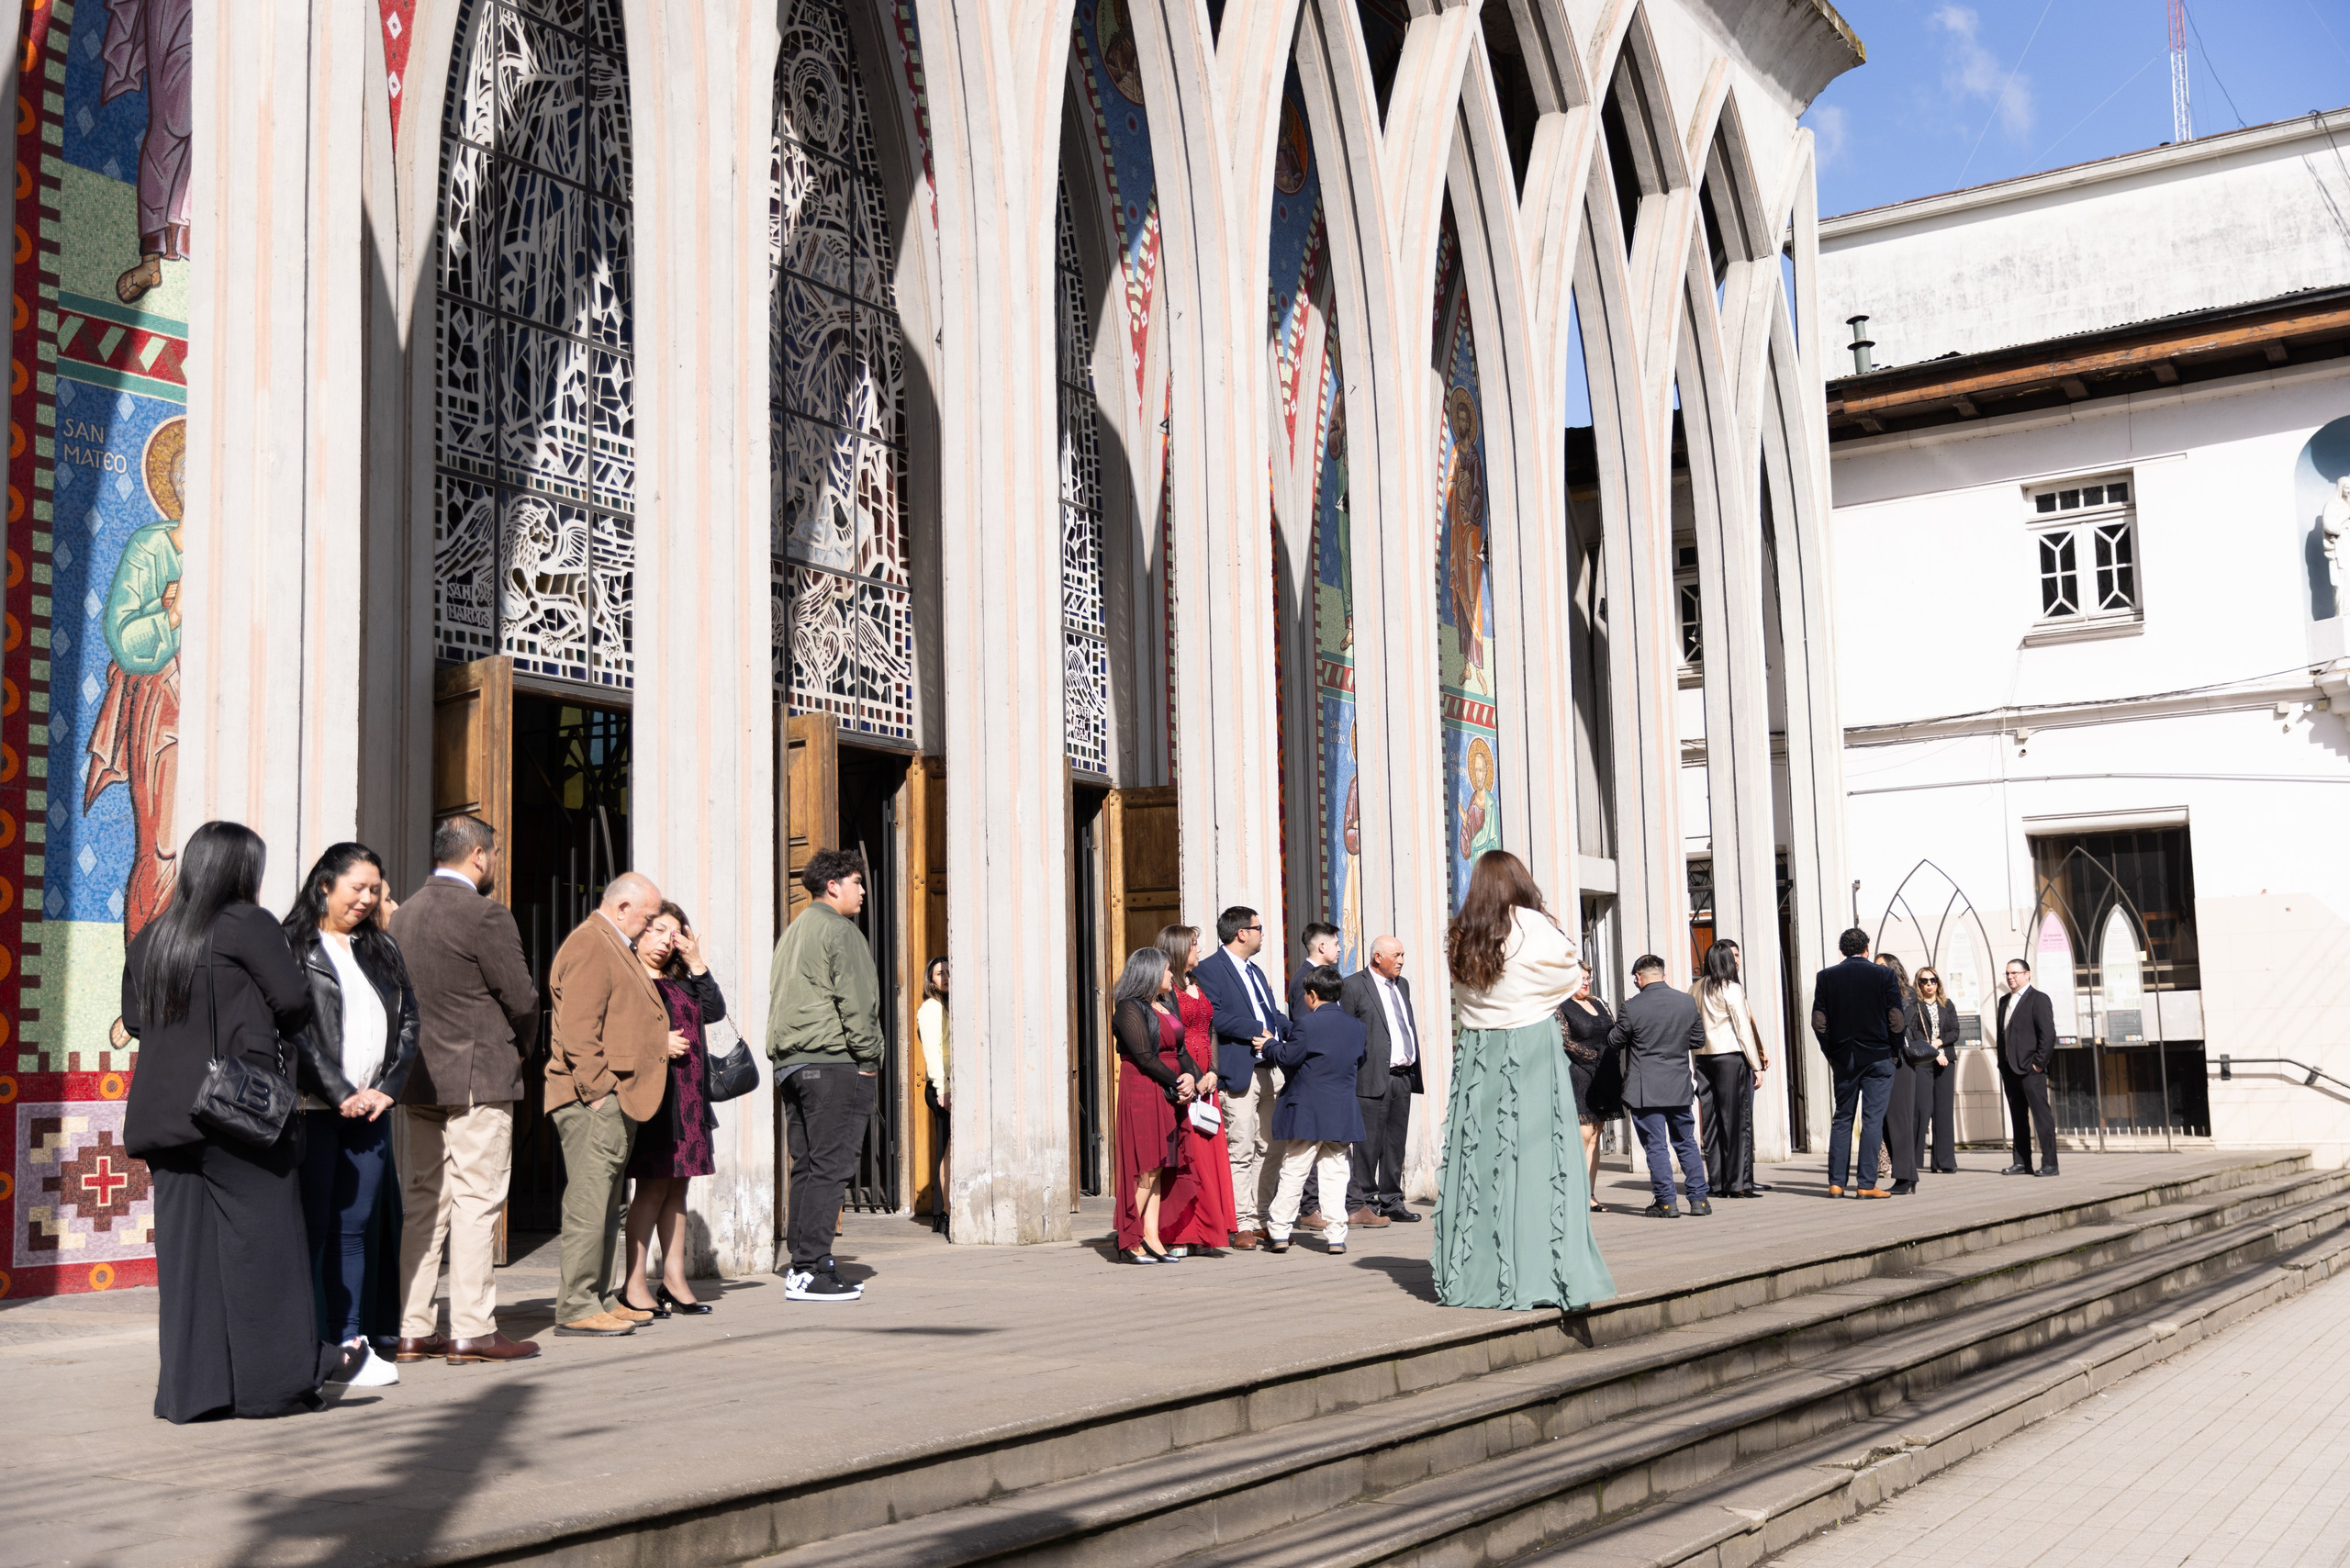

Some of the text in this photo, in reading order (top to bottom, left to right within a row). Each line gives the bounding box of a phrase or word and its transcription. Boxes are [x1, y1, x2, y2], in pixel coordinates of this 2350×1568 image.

[62, 419, 103, 443] SAN
[63, 443, 128, 474] MATEO
[447, 583, 473, 600] SAN
[1330, 719, 1341, 730] SAN
[1329, 732, 1347, 745] LUCAS
[1450, 751, 1462, 764] SAN
